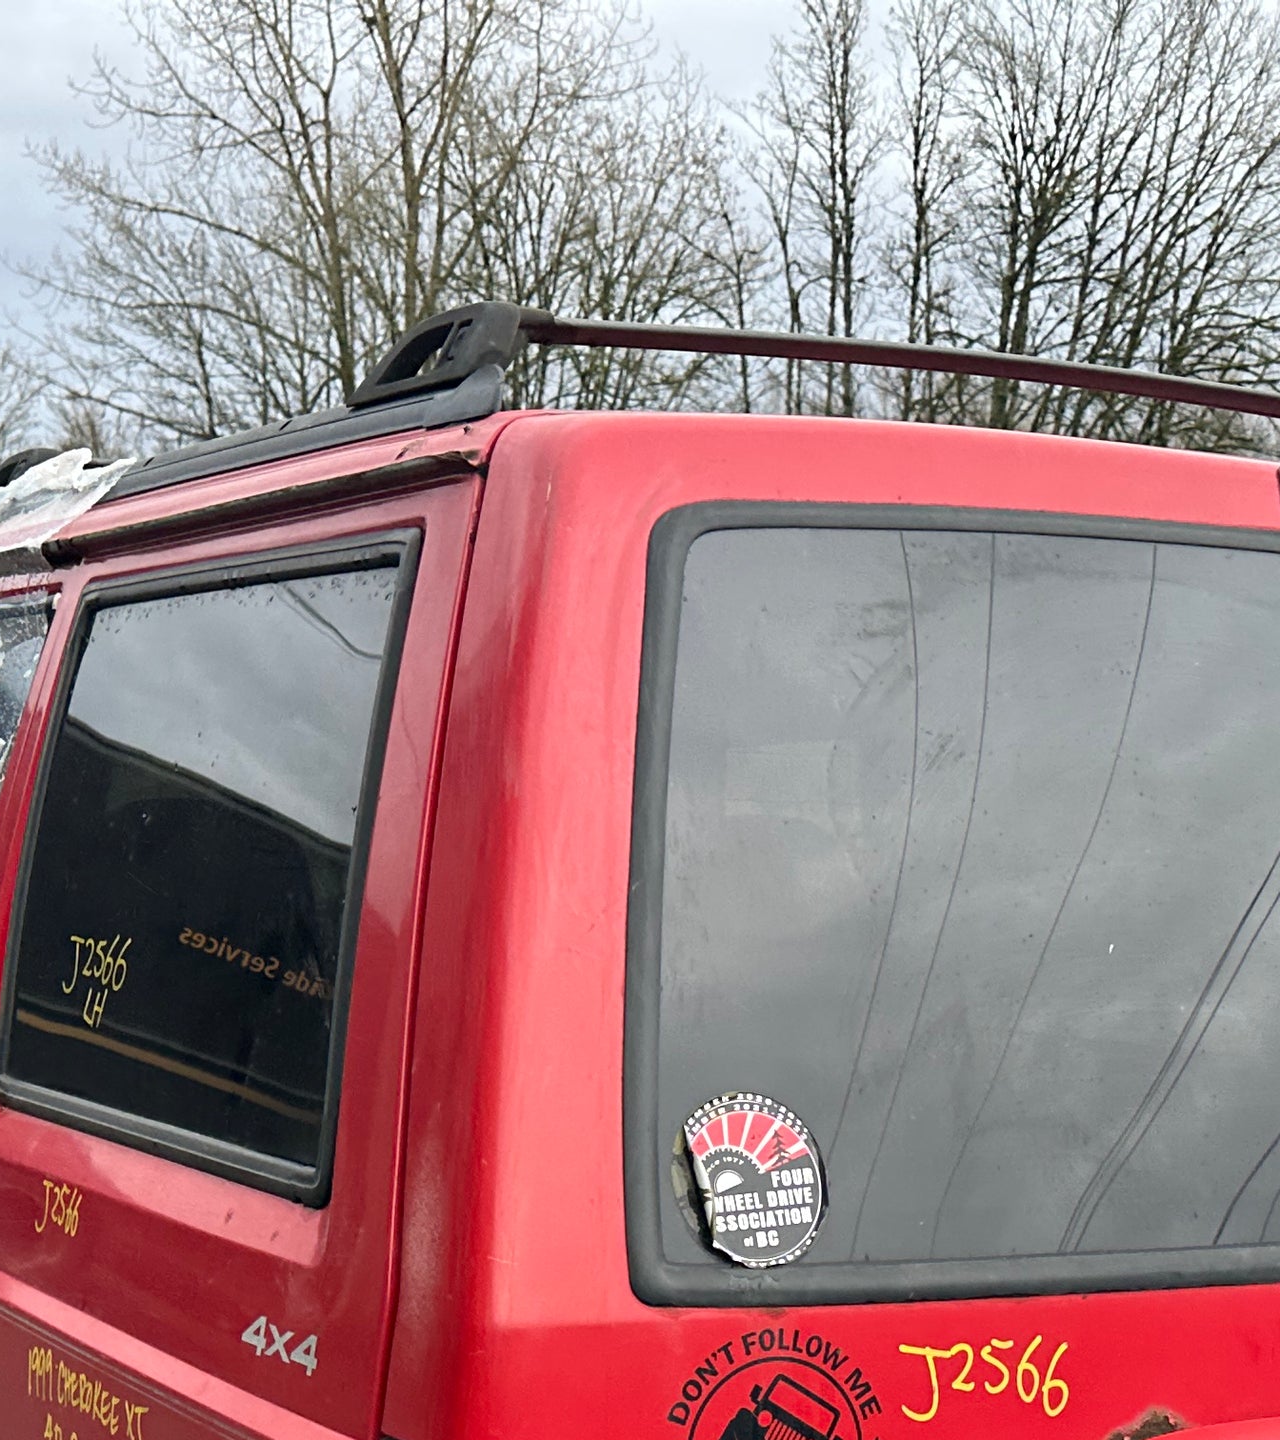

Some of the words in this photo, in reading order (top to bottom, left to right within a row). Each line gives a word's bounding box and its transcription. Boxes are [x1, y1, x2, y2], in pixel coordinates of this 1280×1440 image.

[62, 933, 134, 994] J2566
[83, 987, 109, 1028] LH
[766, 1186, 814, 1208] DRIVE
[770, 1167, 815, 1188] FOUR
[34, 1179, 83, 1238] J2566
[714, 1206, 813, 1233] SSOCIATION
[743, 1235, 754, 1247] of
[755, 1229, 780, 1248] BC
[28, 1346, 53, 1402] 1999
[56, 1359, 120, 1435] CHEROKEE
[667, 1341, 736, 1427] DON'T
[741, 1328, 849, 1371] FOLLOW
[843, 1367, 883, 1421] ME
[899, 1334, 1070, 1422] J2566
